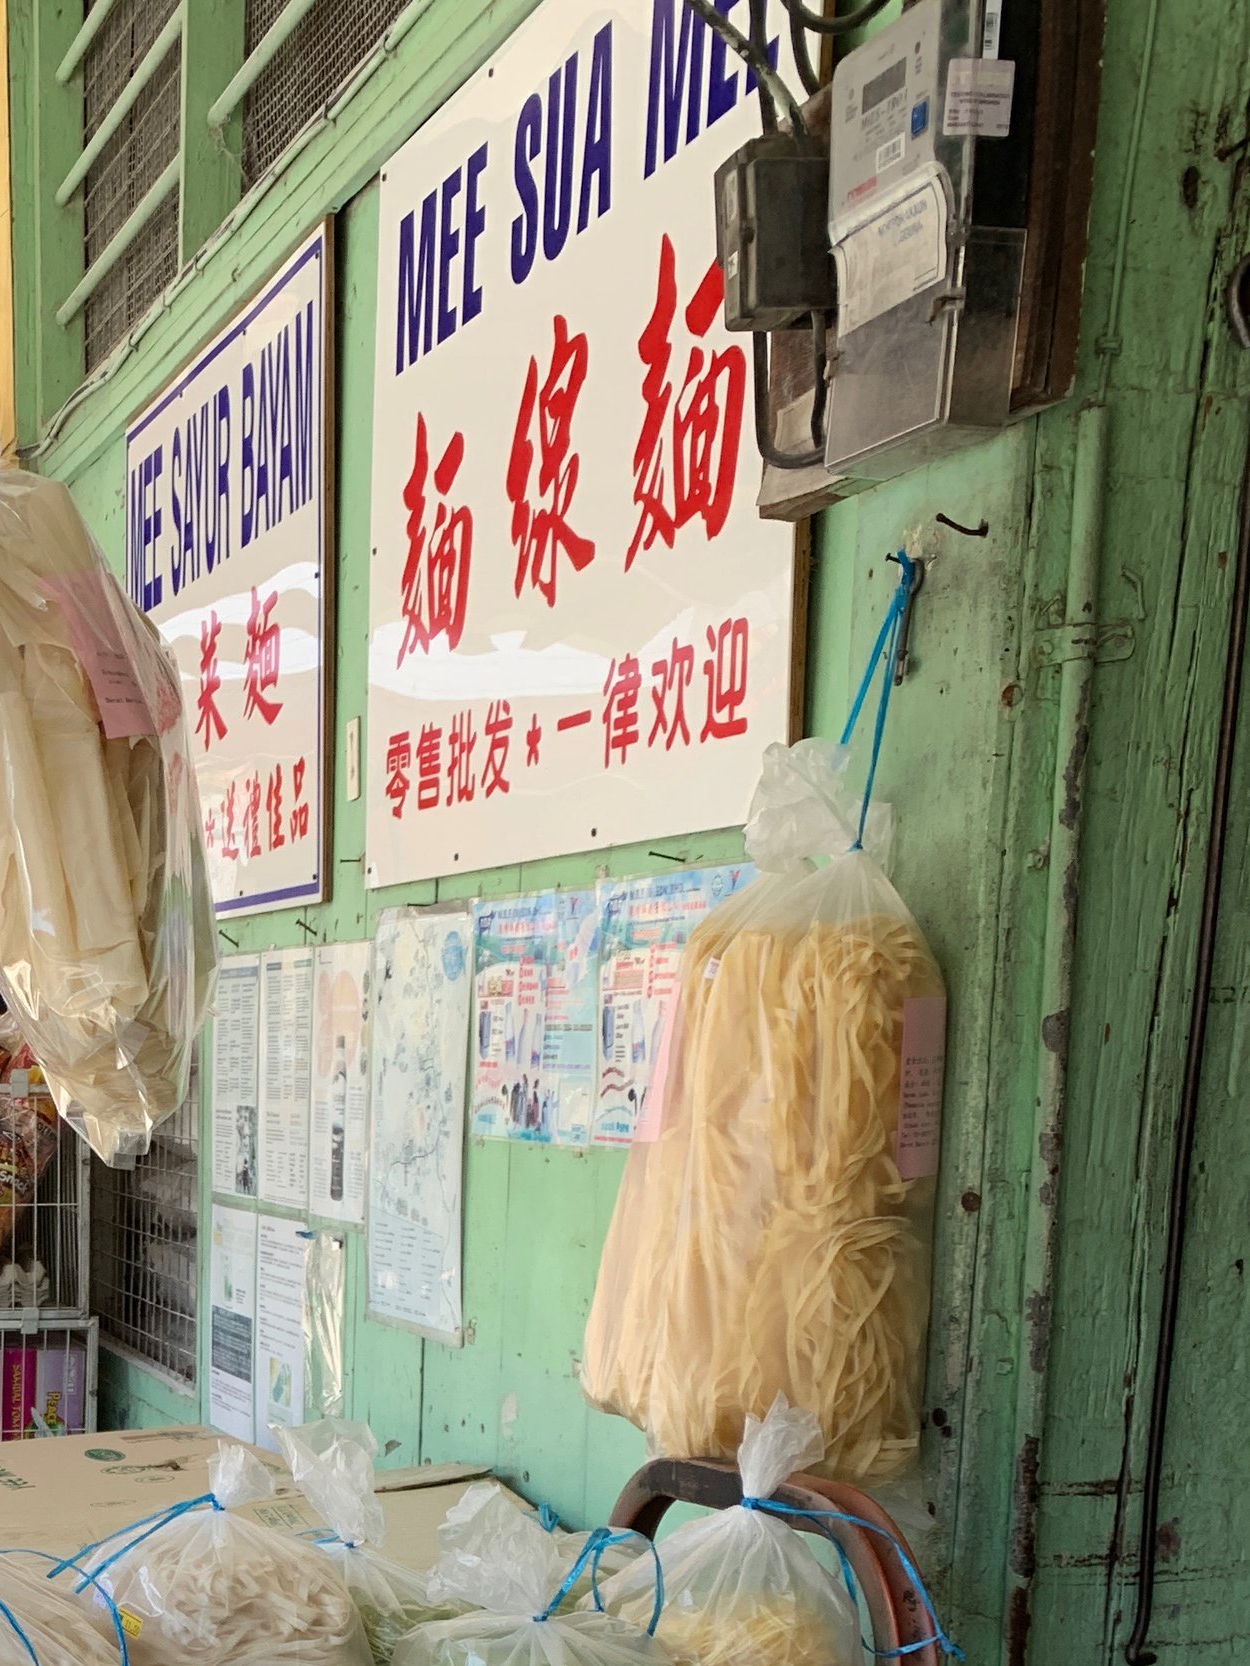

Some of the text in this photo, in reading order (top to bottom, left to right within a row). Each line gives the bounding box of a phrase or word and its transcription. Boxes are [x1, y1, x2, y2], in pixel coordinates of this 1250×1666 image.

[395, 141, 488, 377] MEE
[510, 20, 613, 285] SUA
[131, 300, 313, 613] MEE SAYUR BAYAM
[385, 617, 749, 820] 零售批发 一律欢迎
